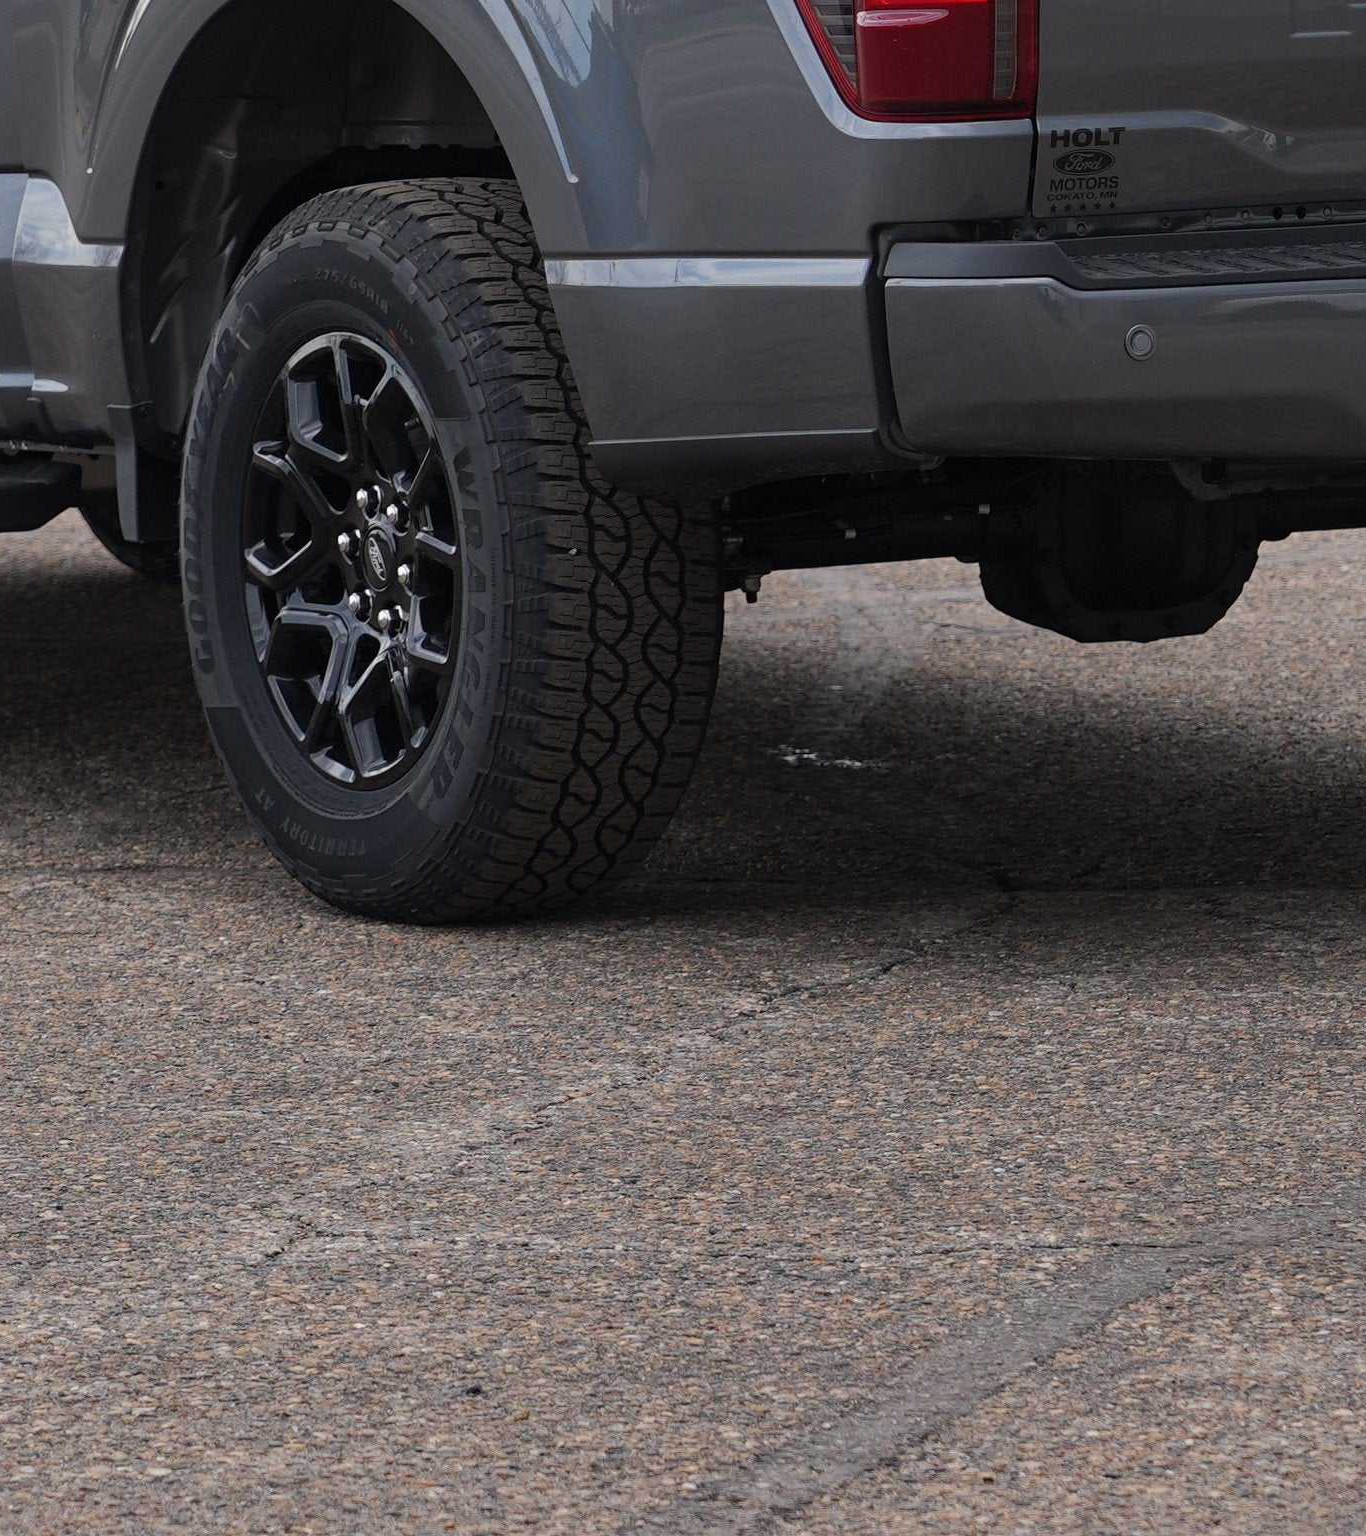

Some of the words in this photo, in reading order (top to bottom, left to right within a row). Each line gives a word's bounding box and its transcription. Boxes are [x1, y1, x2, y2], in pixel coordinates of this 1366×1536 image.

[1050, 126, 1126, 148] HOLT
[1049, 175, 1119, 192] MOTORS
[1099, 190, 1118, 200] MN
[431, 445, 486, 801] WRANGLER
[278, 816, 367, 857] TERRITORY
